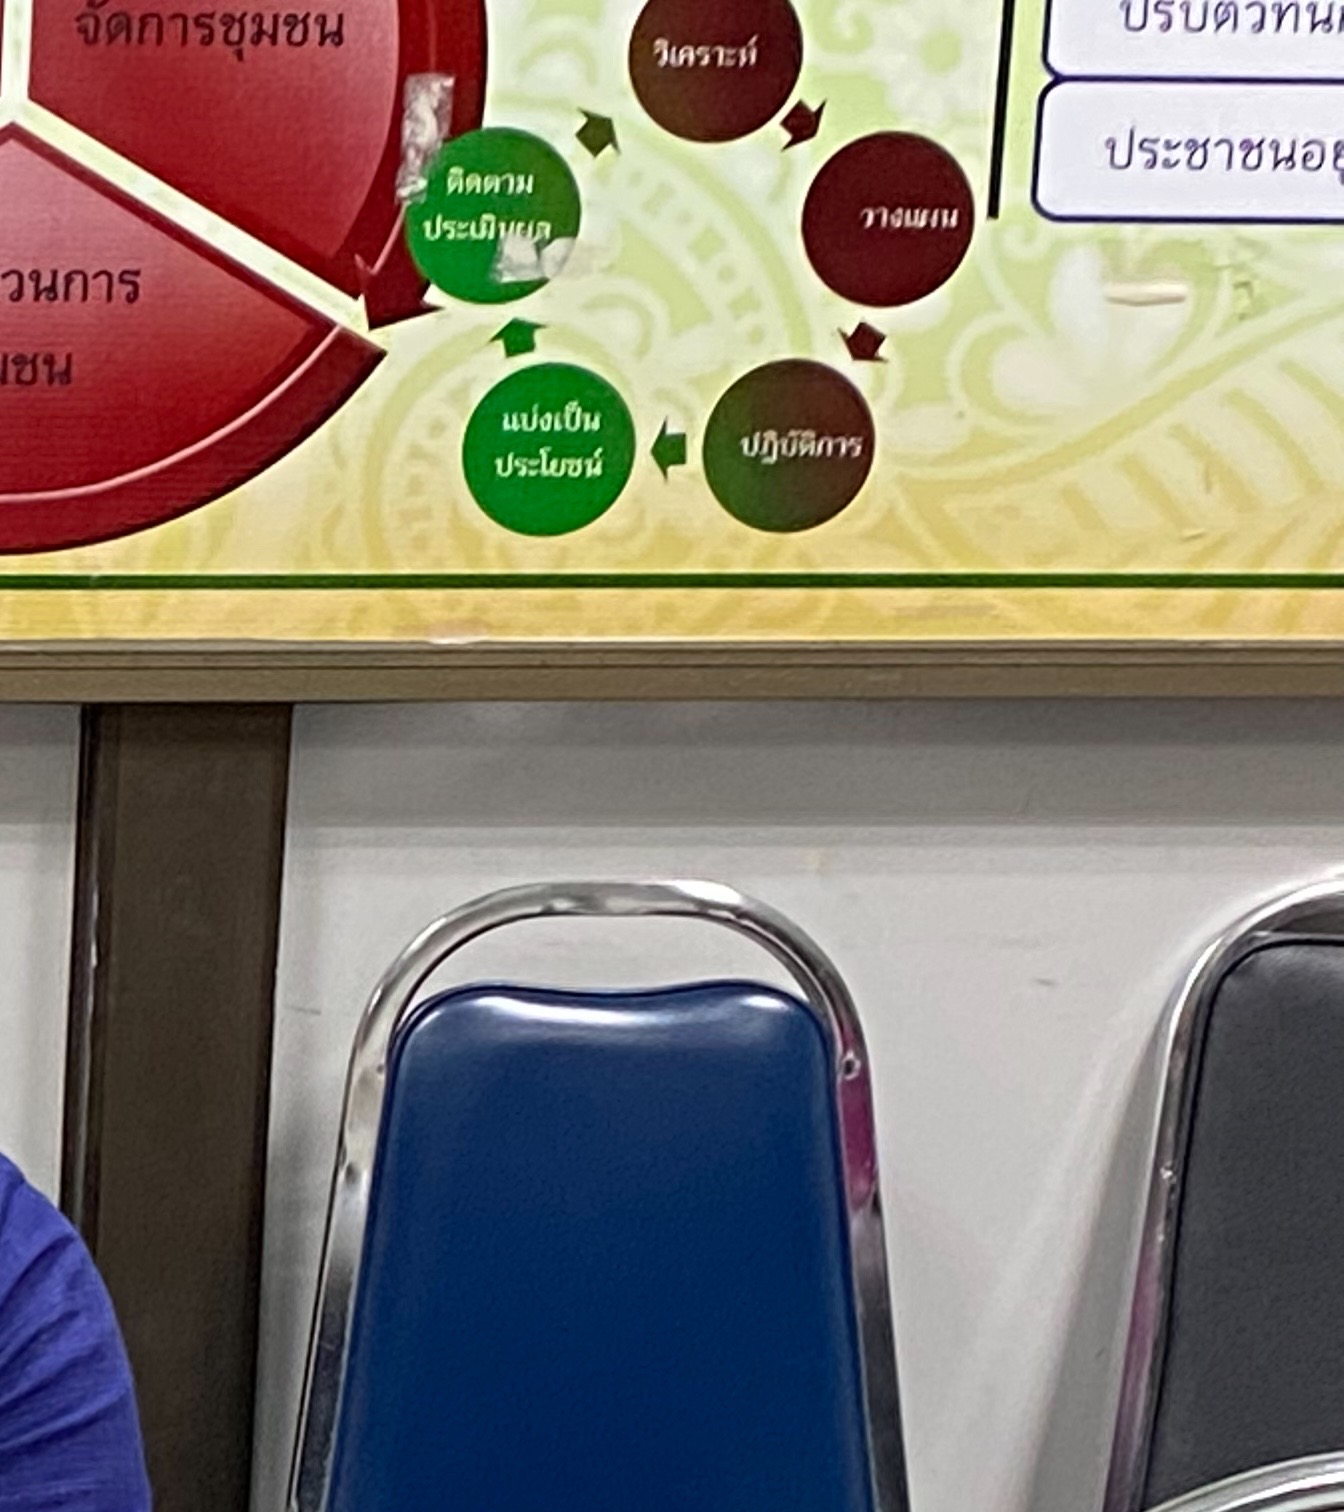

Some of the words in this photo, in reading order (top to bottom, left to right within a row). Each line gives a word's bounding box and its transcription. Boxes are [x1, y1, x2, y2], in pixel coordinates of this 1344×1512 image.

[653, 34, 759, 68] วิเคราะห์
[447, 166, 534, 195] ติดตาม
[859, 206, 959, 229] วางแผน
[495, 446, 604, 478] ประโยชน์
[740, 429, 864, 465] ปฏิบัติการ
